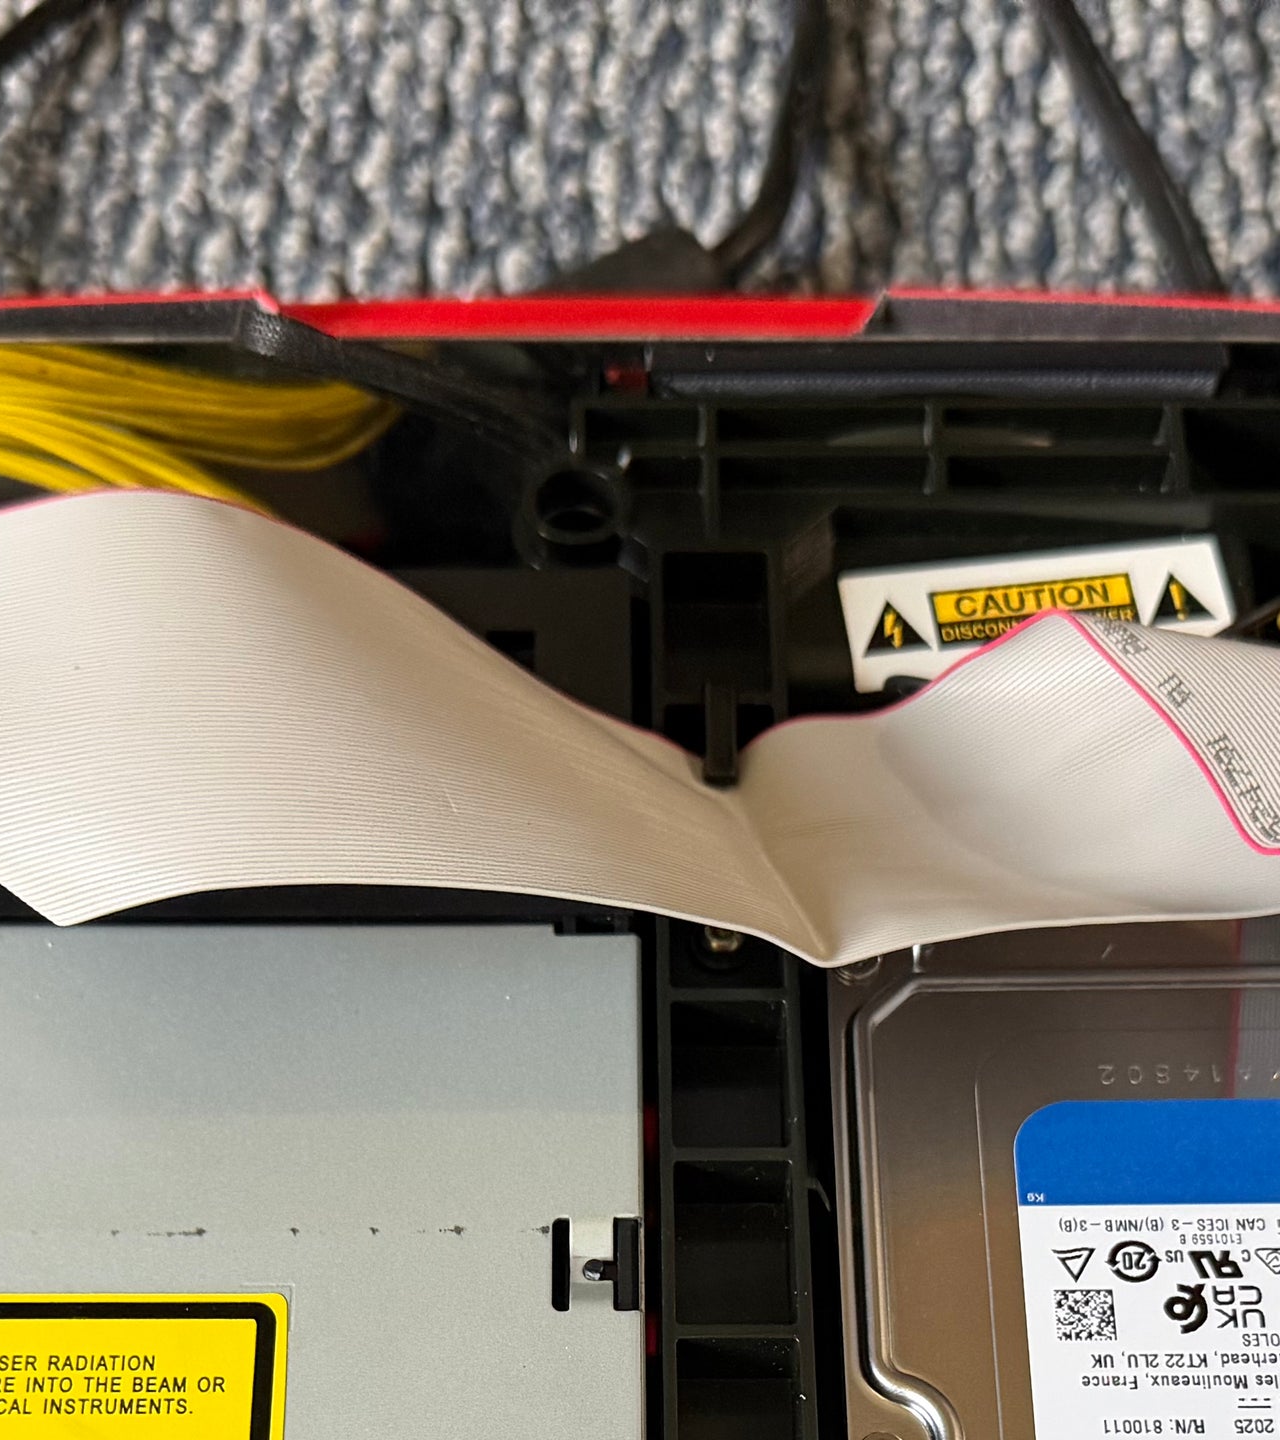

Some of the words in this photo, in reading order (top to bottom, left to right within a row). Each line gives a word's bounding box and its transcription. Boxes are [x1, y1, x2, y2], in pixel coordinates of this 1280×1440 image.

[954, 582, 1111, 618] CAUTION
[48, 1355, 155, 1371] RADIATION
[1091, 1354, 1114, 1368] UK
[1122, 1352, 1159, 1368] 2LU,
[1165, 1354, 1207, 1368] KT22
[26, 1377, 72, 1392] INTO
[84, 1377, 121, 1392] THE
[133, 1377, 186, 1392] BEAM
[198, 1377, 224, 1392] OR
[1082, 1376, 1138, 1389] France
[1146, 1374, 1248, 1389] Moulineaux,
[1256, 1375, 1278, 1389] les
[44, 1398, 194, 1414] INSTRUMENTS.
[1104, 1420, 1162, 1434] 810011
[1170, 1419, 1205, 1433] R/N:
[1235, 1419, 1274, 1433] 2025
